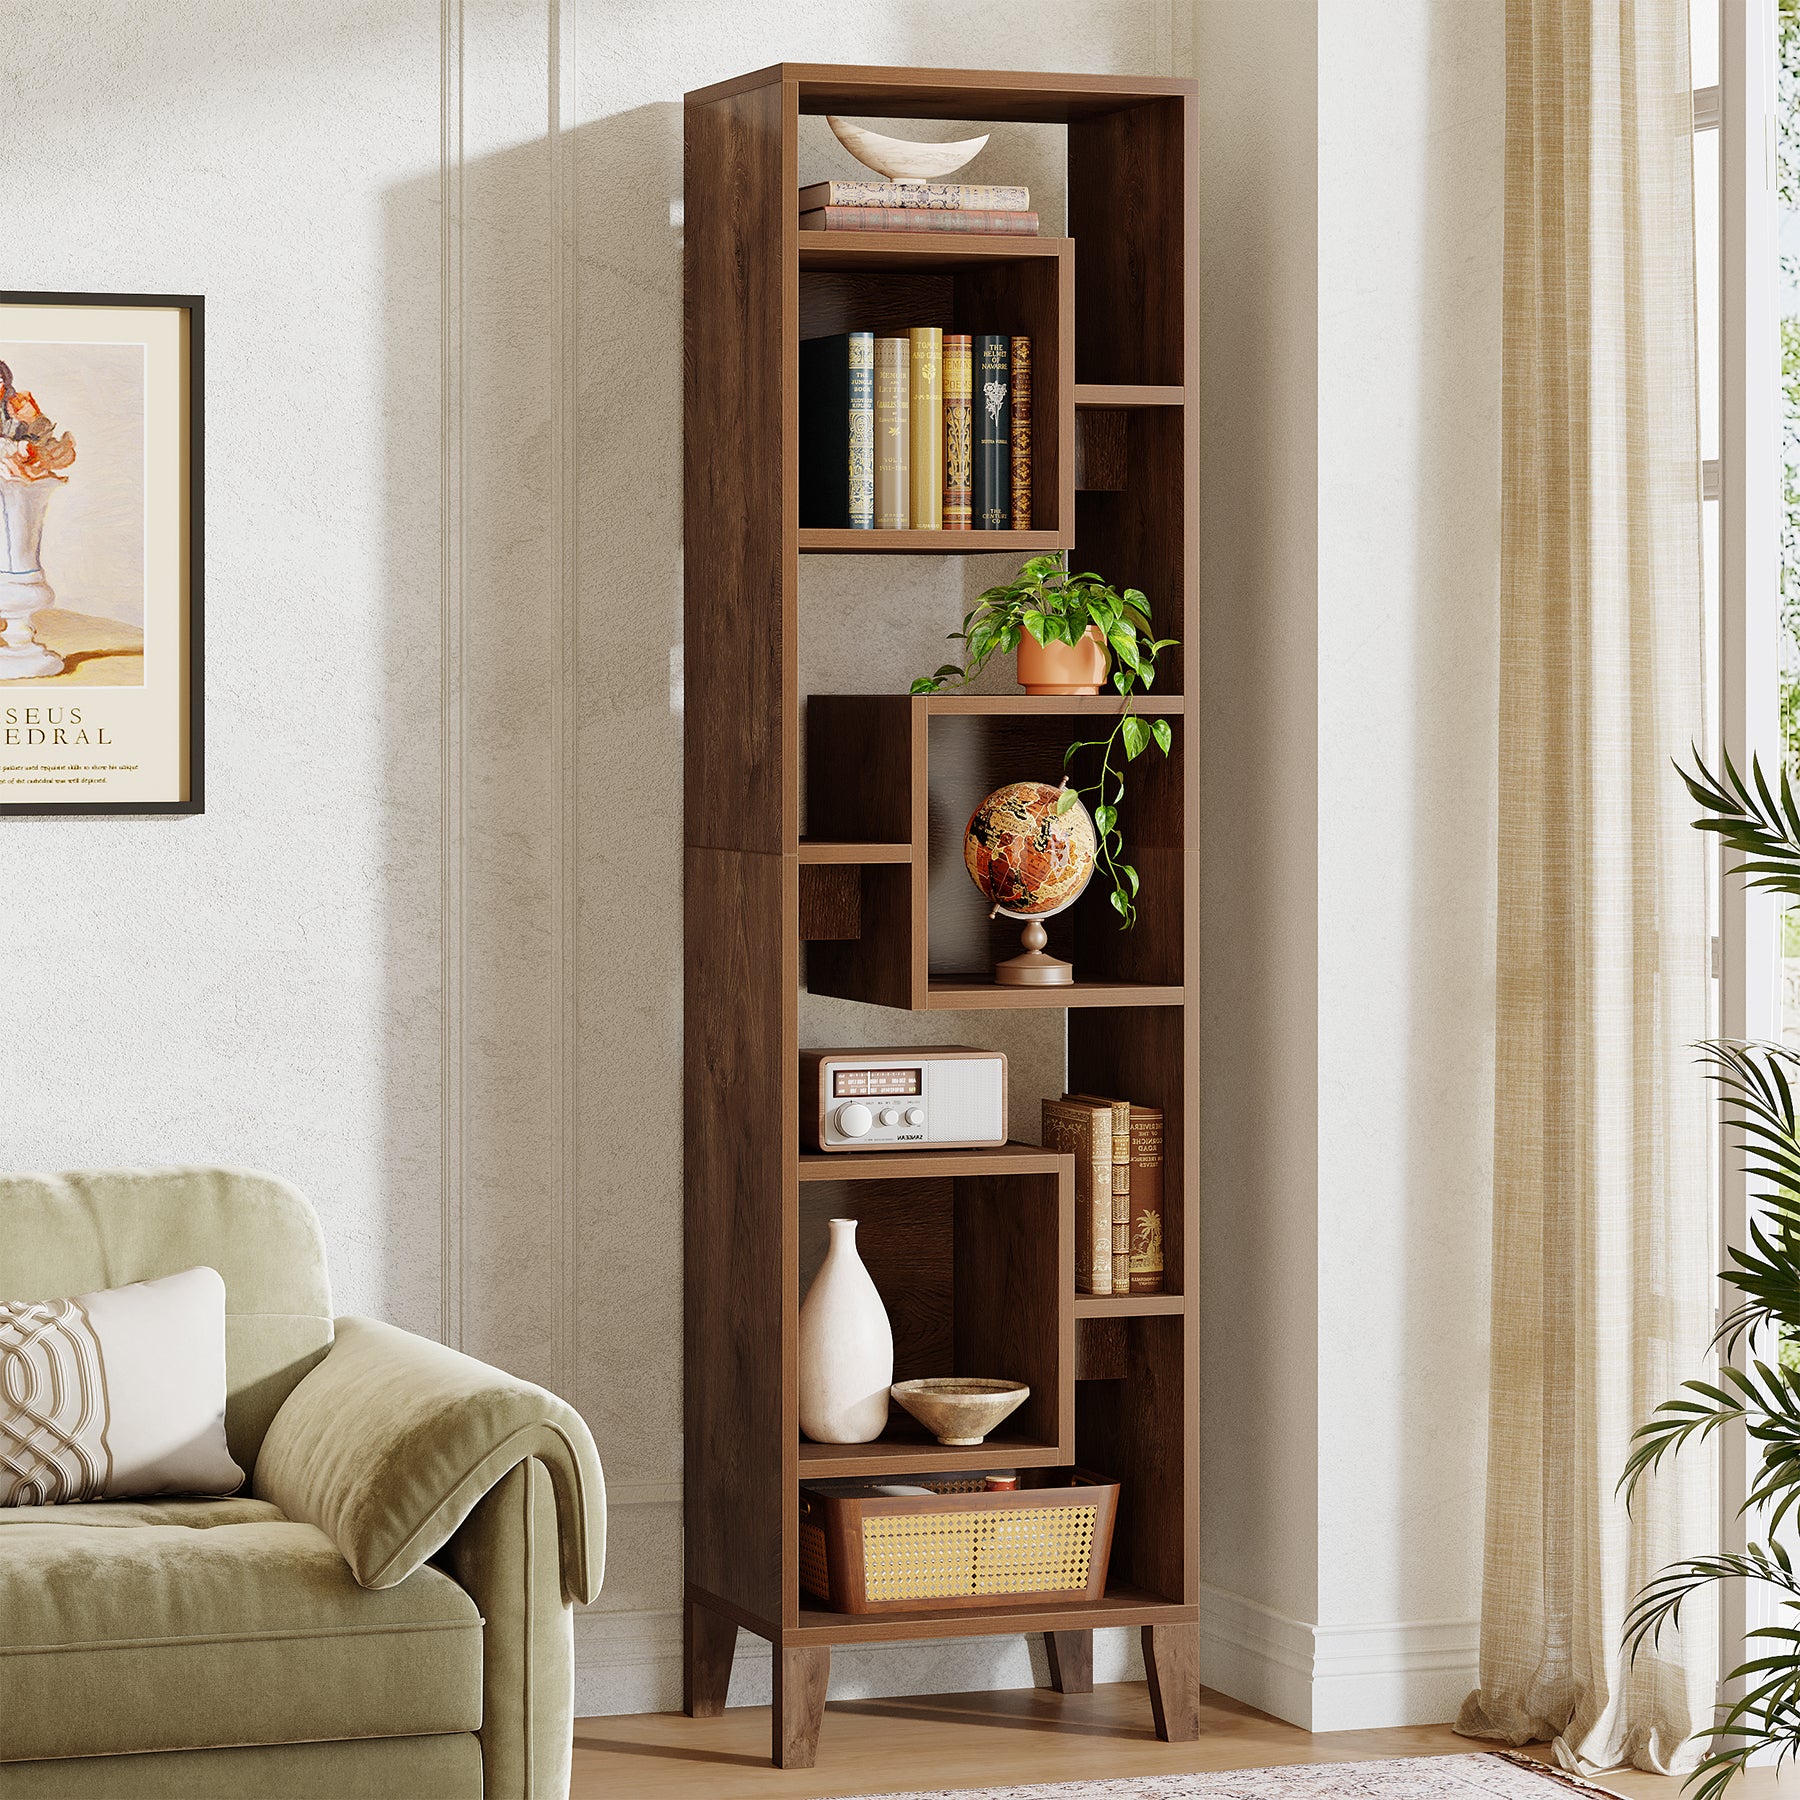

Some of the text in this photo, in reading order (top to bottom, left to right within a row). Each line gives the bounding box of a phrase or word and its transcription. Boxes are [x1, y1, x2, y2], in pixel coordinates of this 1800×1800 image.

[943, 379, 972, 390] POEMS
[0, 707, 82, 725] SEUS
[5, 728, 113, 745] EDRAL
